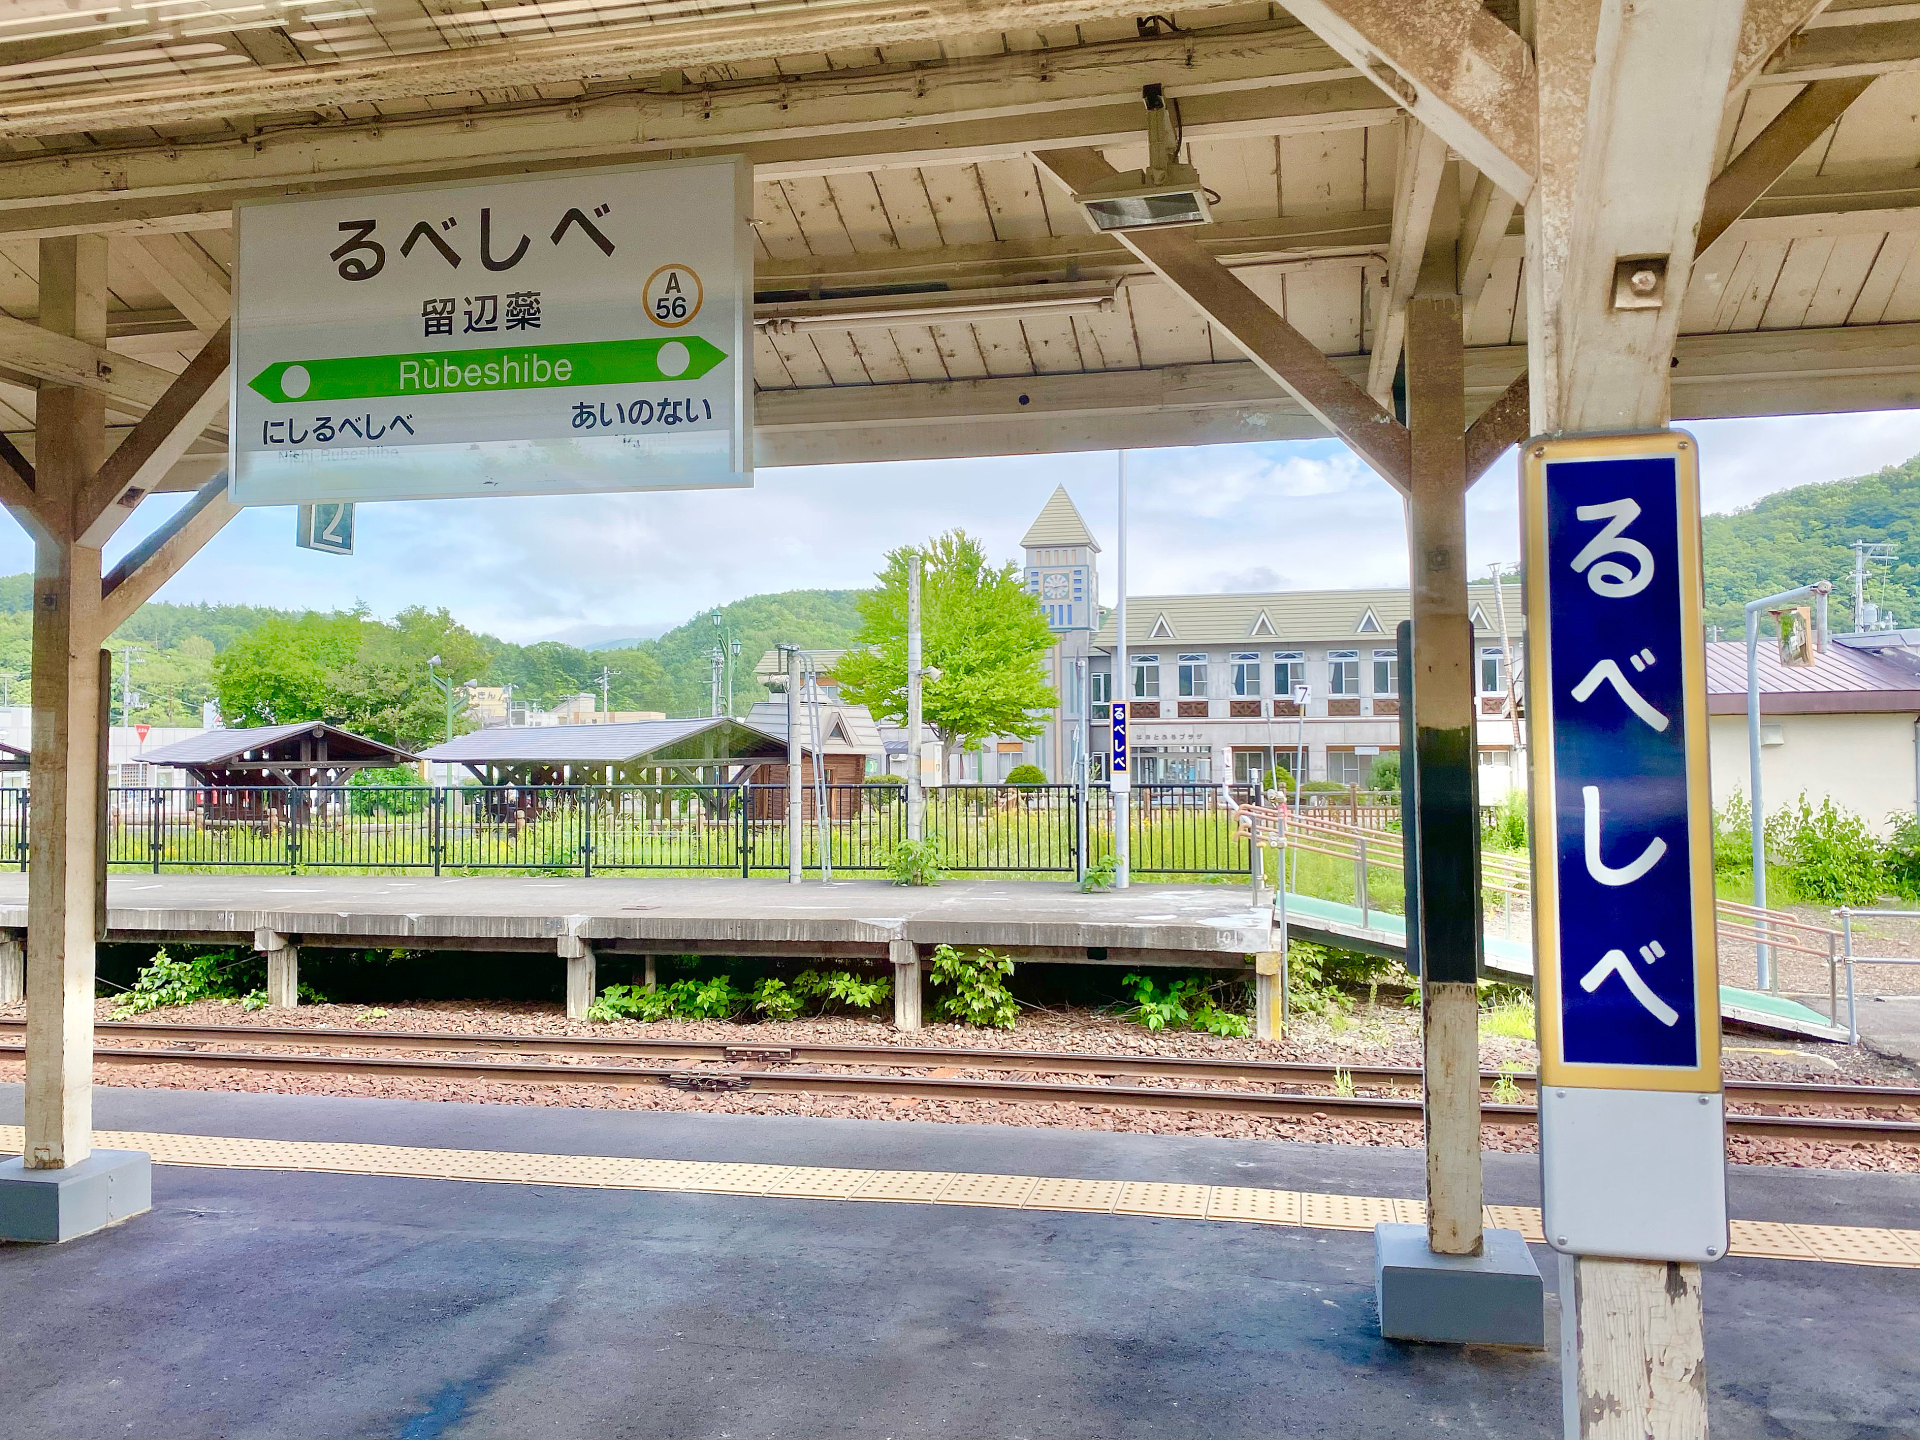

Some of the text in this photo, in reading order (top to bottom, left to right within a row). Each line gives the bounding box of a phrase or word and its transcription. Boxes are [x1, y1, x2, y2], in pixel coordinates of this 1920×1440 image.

[329, 203, 616, 282] るべしべ
[665, 272, 681, 294] A
[656, 296, 687, 320] 56
[400, 353, 572, 390] Rubeshibe
[263, 413, 415, 445] にしるべしべ
[571, 397, 712, 430] あいのない
[1299, 687, 1308, 702] 7
[1114, 707, 1125, 767] るべしべ
[1570, 497, 1680, 1027] るべしべ
